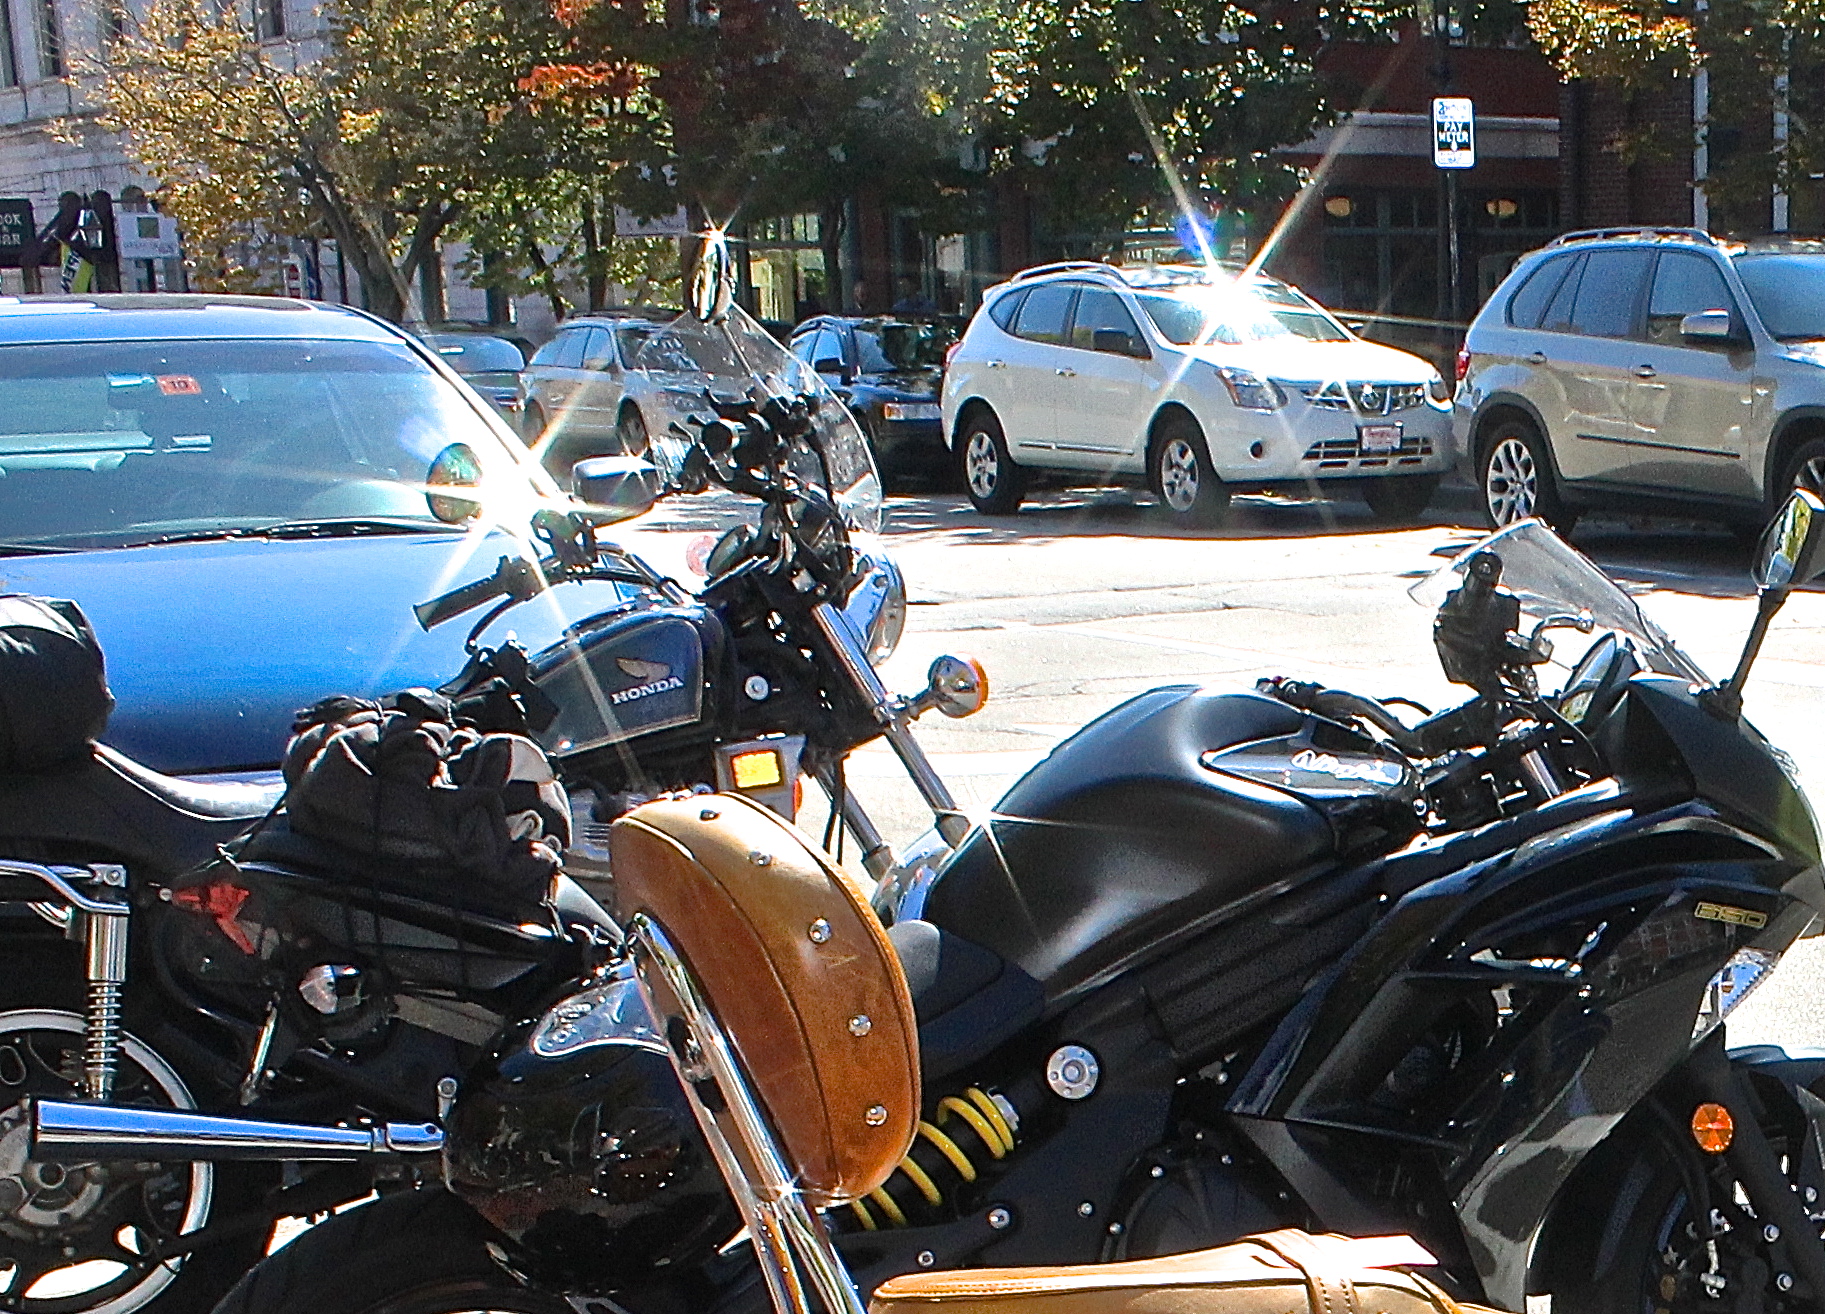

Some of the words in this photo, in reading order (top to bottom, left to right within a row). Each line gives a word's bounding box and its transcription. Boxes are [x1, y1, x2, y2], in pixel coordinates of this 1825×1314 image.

[1443, 121, 1463, 131] PAY
[1438, 131, 1469, 142] METER
[170, 380, 188, 389] 10
[611, 676, 684, 705] HONDA
